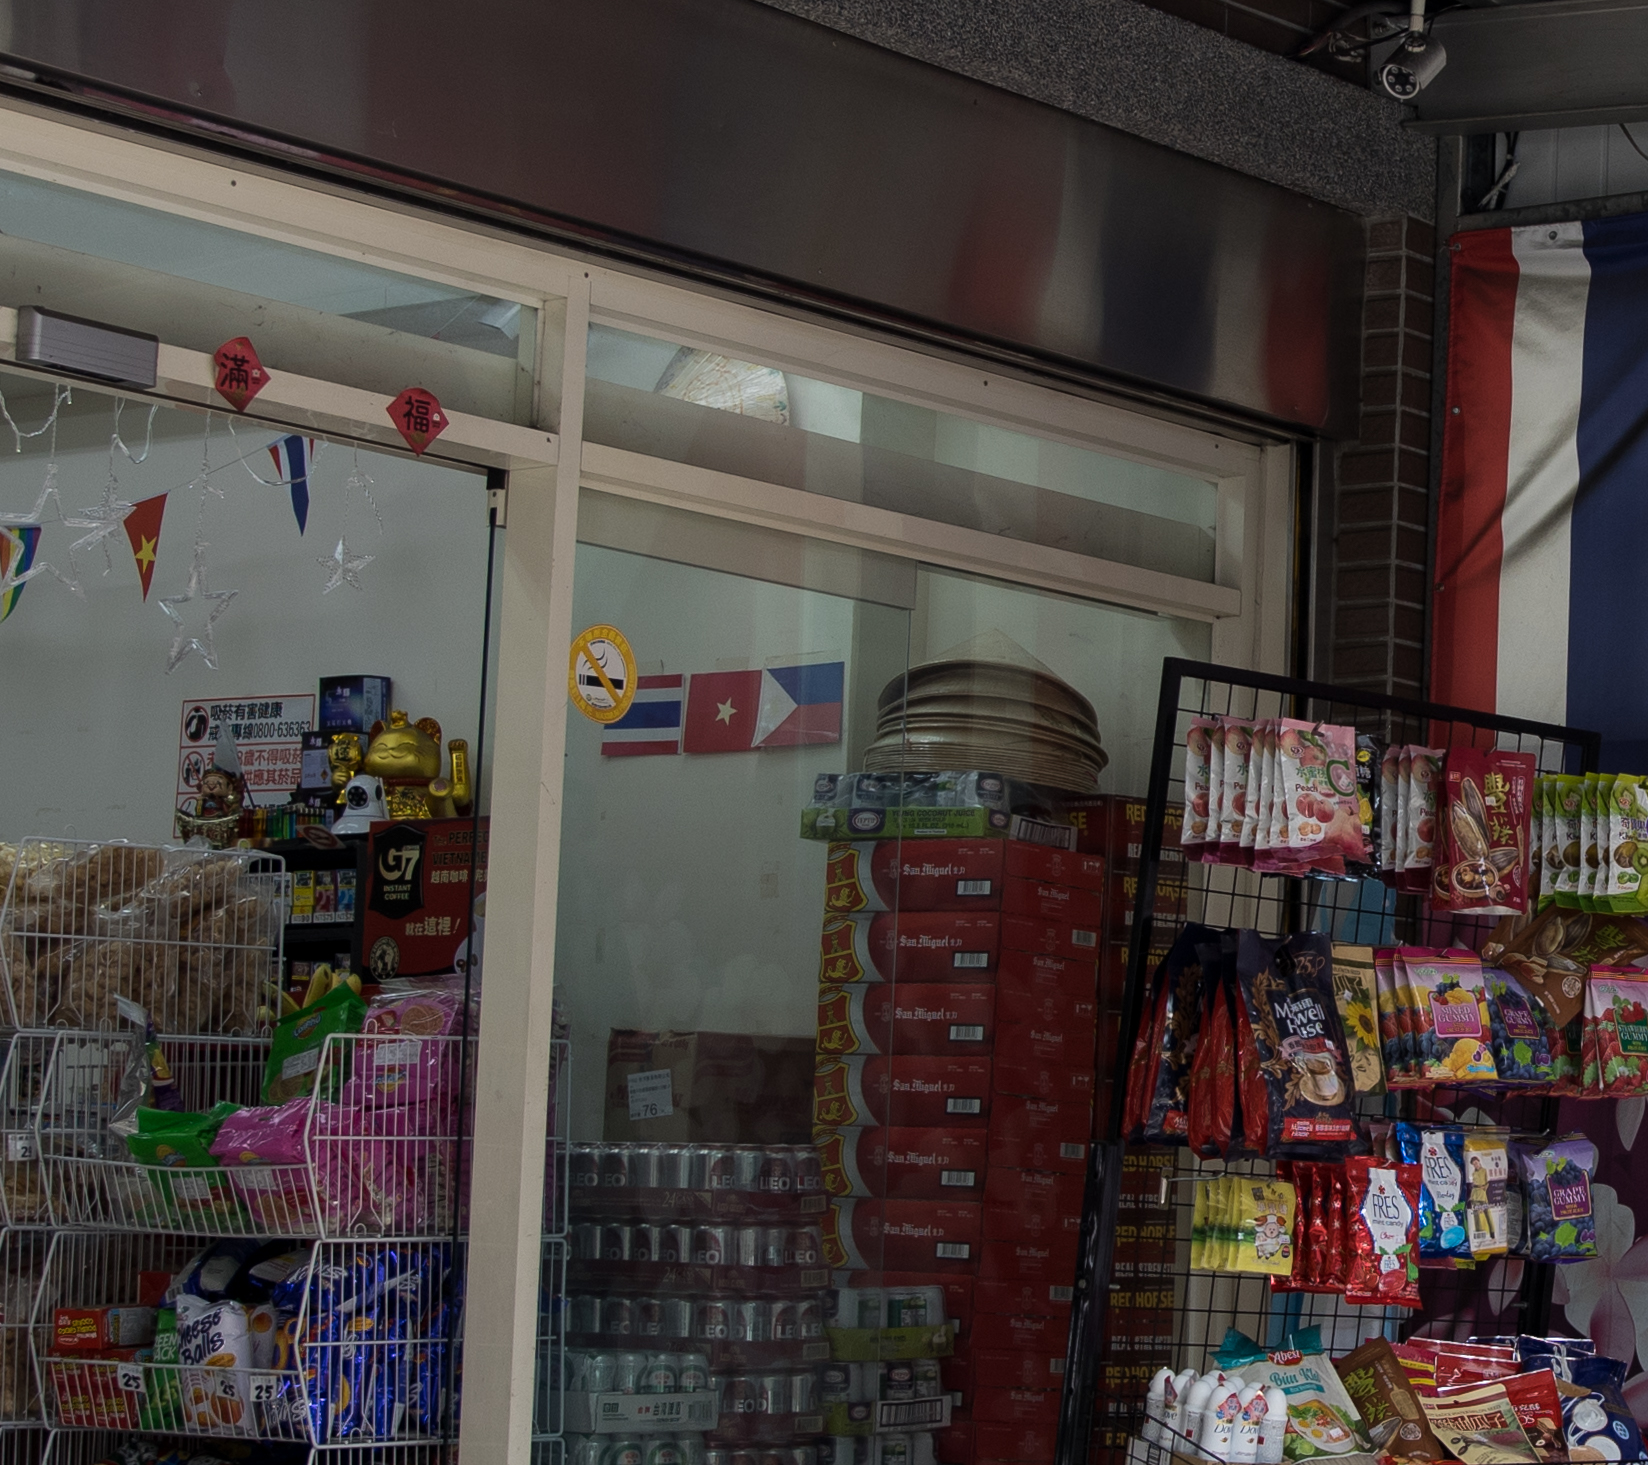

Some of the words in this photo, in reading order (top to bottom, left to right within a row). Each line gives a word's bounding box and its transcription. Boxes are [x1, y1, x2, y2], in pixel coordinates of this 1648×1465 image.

[217, 353, 253, 391] 滿
[402, 396, 433, 436] 福
[208, 719, 312, 742] 戒專線0800-636363
[1295, 783, 1318, 793] Peach
[1437, 1012, 1476, 1024] GUMMY
[1440, 1006, 1472, 1016] MIXED
[642, 1103, 658, 1116] 76
[1552, 1186, 1587, 1199] GRAPE
[1372, 1193, 1400, 1220] FRES
[1552, 1195, 1587, 1206] GUMMY
[181, 1331, 225, 1365] Balls
[122, 1372, 141, 1388] 25
[255, 1384, 273, 1399] 25
